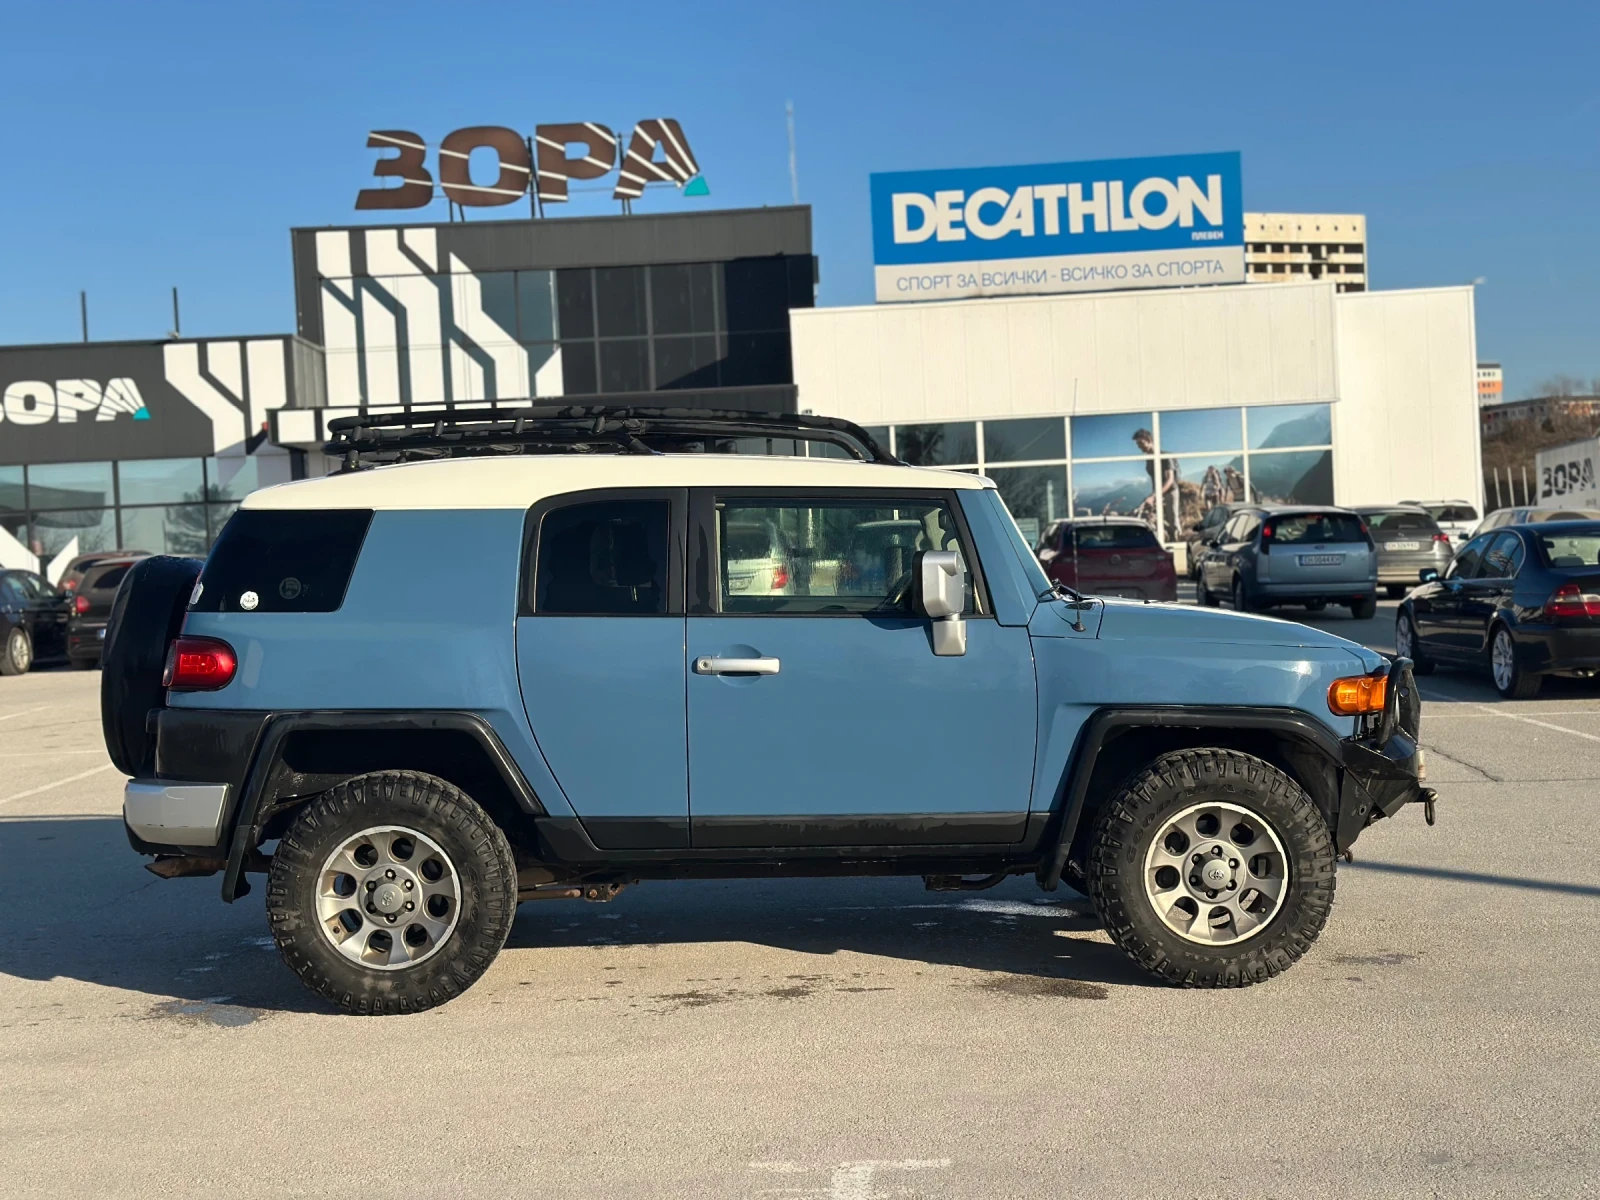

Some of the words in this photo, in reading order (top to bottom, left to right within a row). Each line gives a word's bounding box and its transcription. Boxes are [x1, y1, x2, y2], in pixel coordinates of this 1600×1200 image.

[355, 118, 709, 210] ЗОРА
[892, 174, 1223, 244] DECATHLON
[896, 274, 952, 291] СПОРТ
[957, 273, 978, 288] ЗА
[981, 269, 1047, 287] ВСИЧКИ
[1060, 264, 1128, 282] ВСИЧКО
[1132, 264, 1153, 278] ЗА
[1156, 260, 1224, 277] СПОРТА
[0, 377, 151, 425] ОРА
[1541, 457, 1596, 499] ЗОРА
